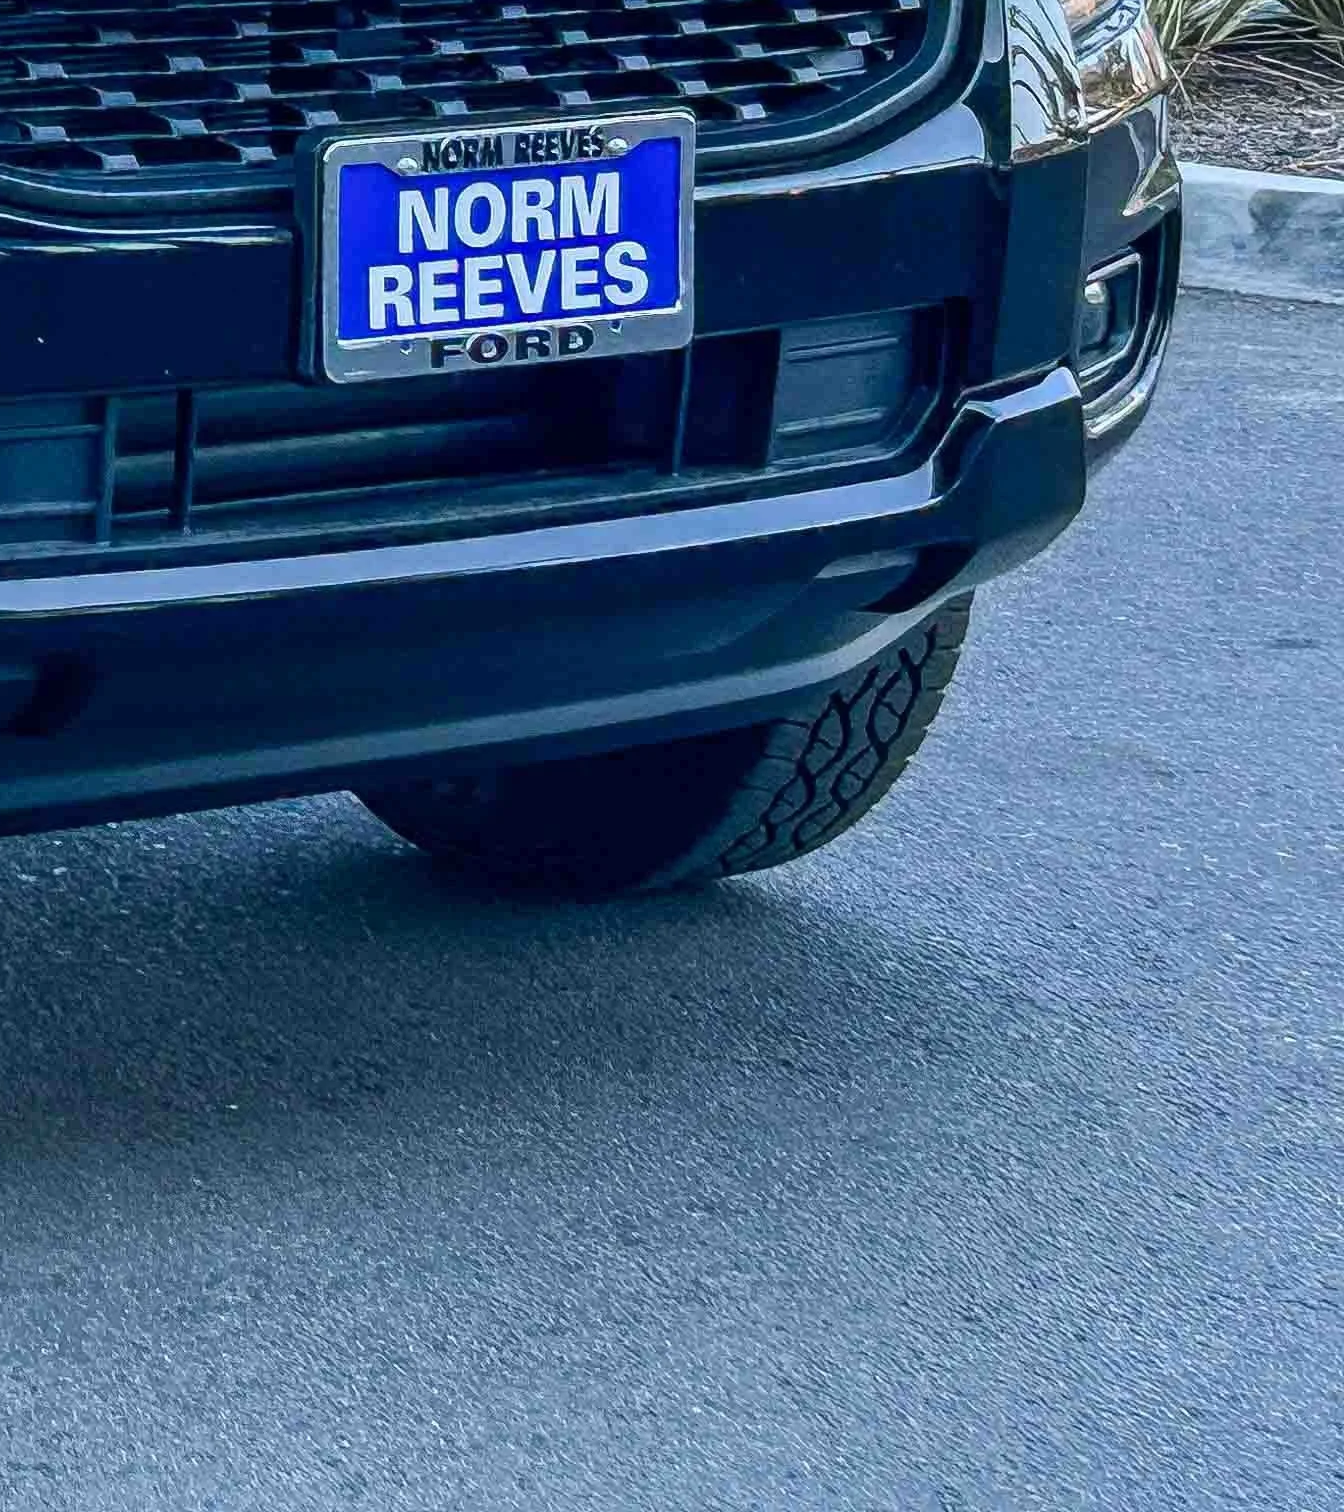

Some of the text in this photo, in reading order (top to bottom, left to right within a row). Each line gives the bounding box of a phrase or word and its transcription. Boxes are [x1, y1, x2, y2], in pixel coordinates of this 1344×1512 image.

[422, 125, 604, 172] NORM REEVES
[399, 172, 620, 253] NORM
[368, 241, 649, 330] REEVES
[430, 323, 595, 368] FORD
